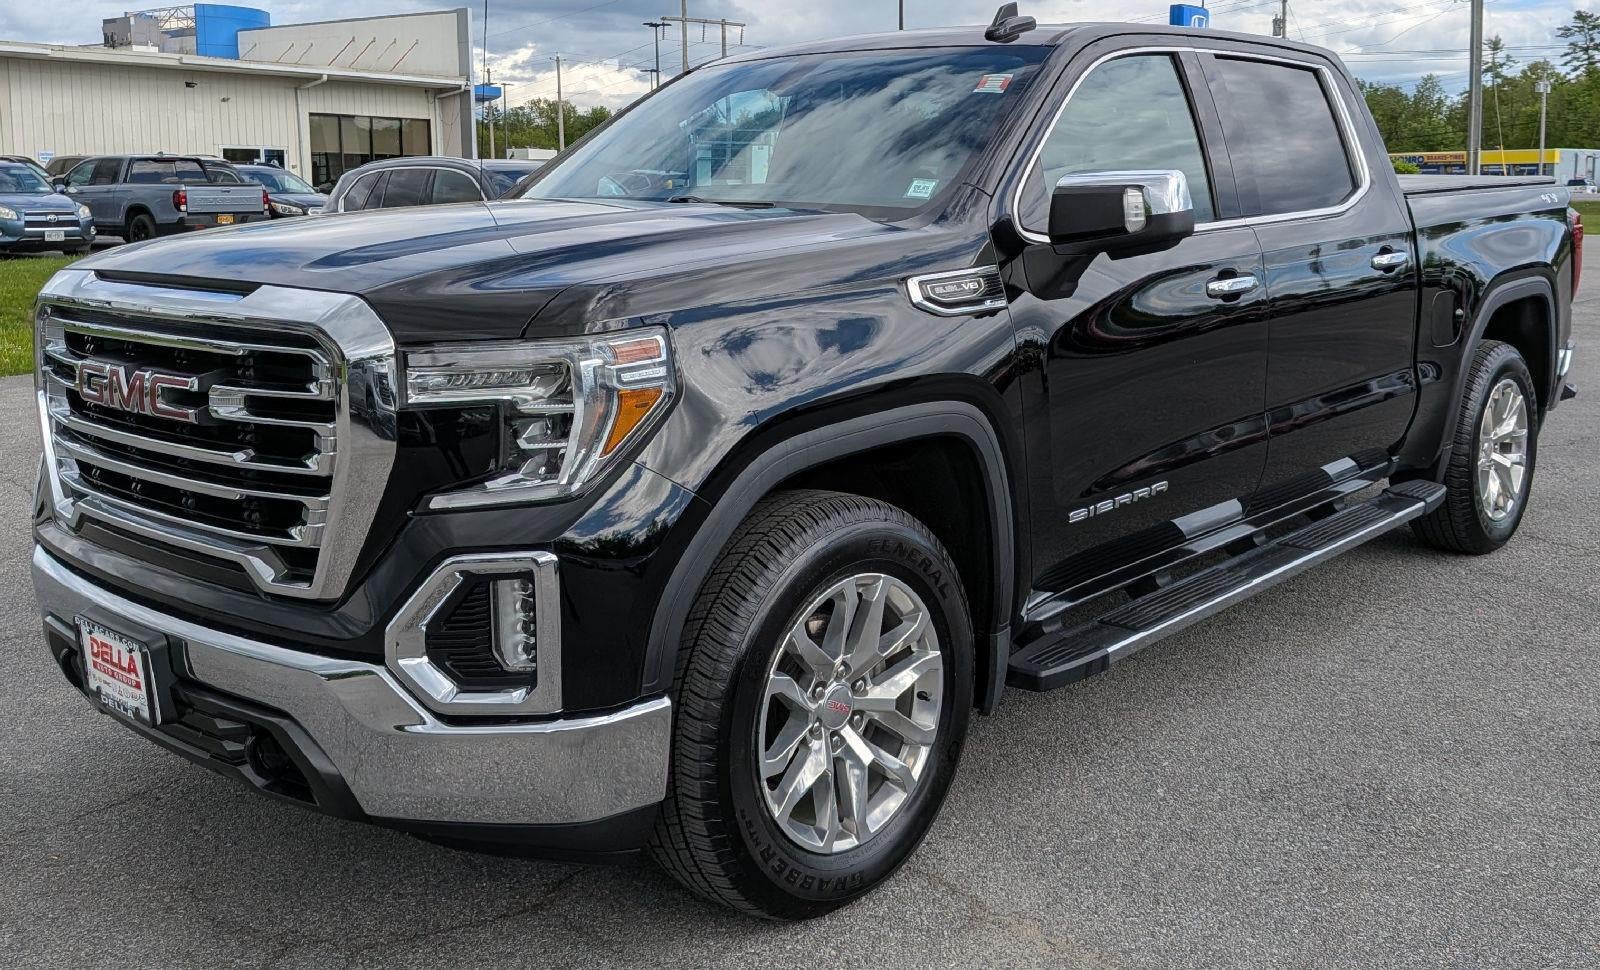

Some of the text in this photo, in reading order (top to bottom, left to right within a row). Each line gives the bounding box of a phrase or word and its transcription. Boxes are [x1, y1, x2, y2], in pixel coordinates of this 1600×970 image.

[78, 360, 199, 424] GMC
[1067, 480, 1169, 524] SIERRA
[863, 537, 949, 600] GENERAL
[89, 635, 140, 679] DELLA
[97, 662, 137, 687] AUTO GROUP
[760, 846, 864, 890] GRABBER
